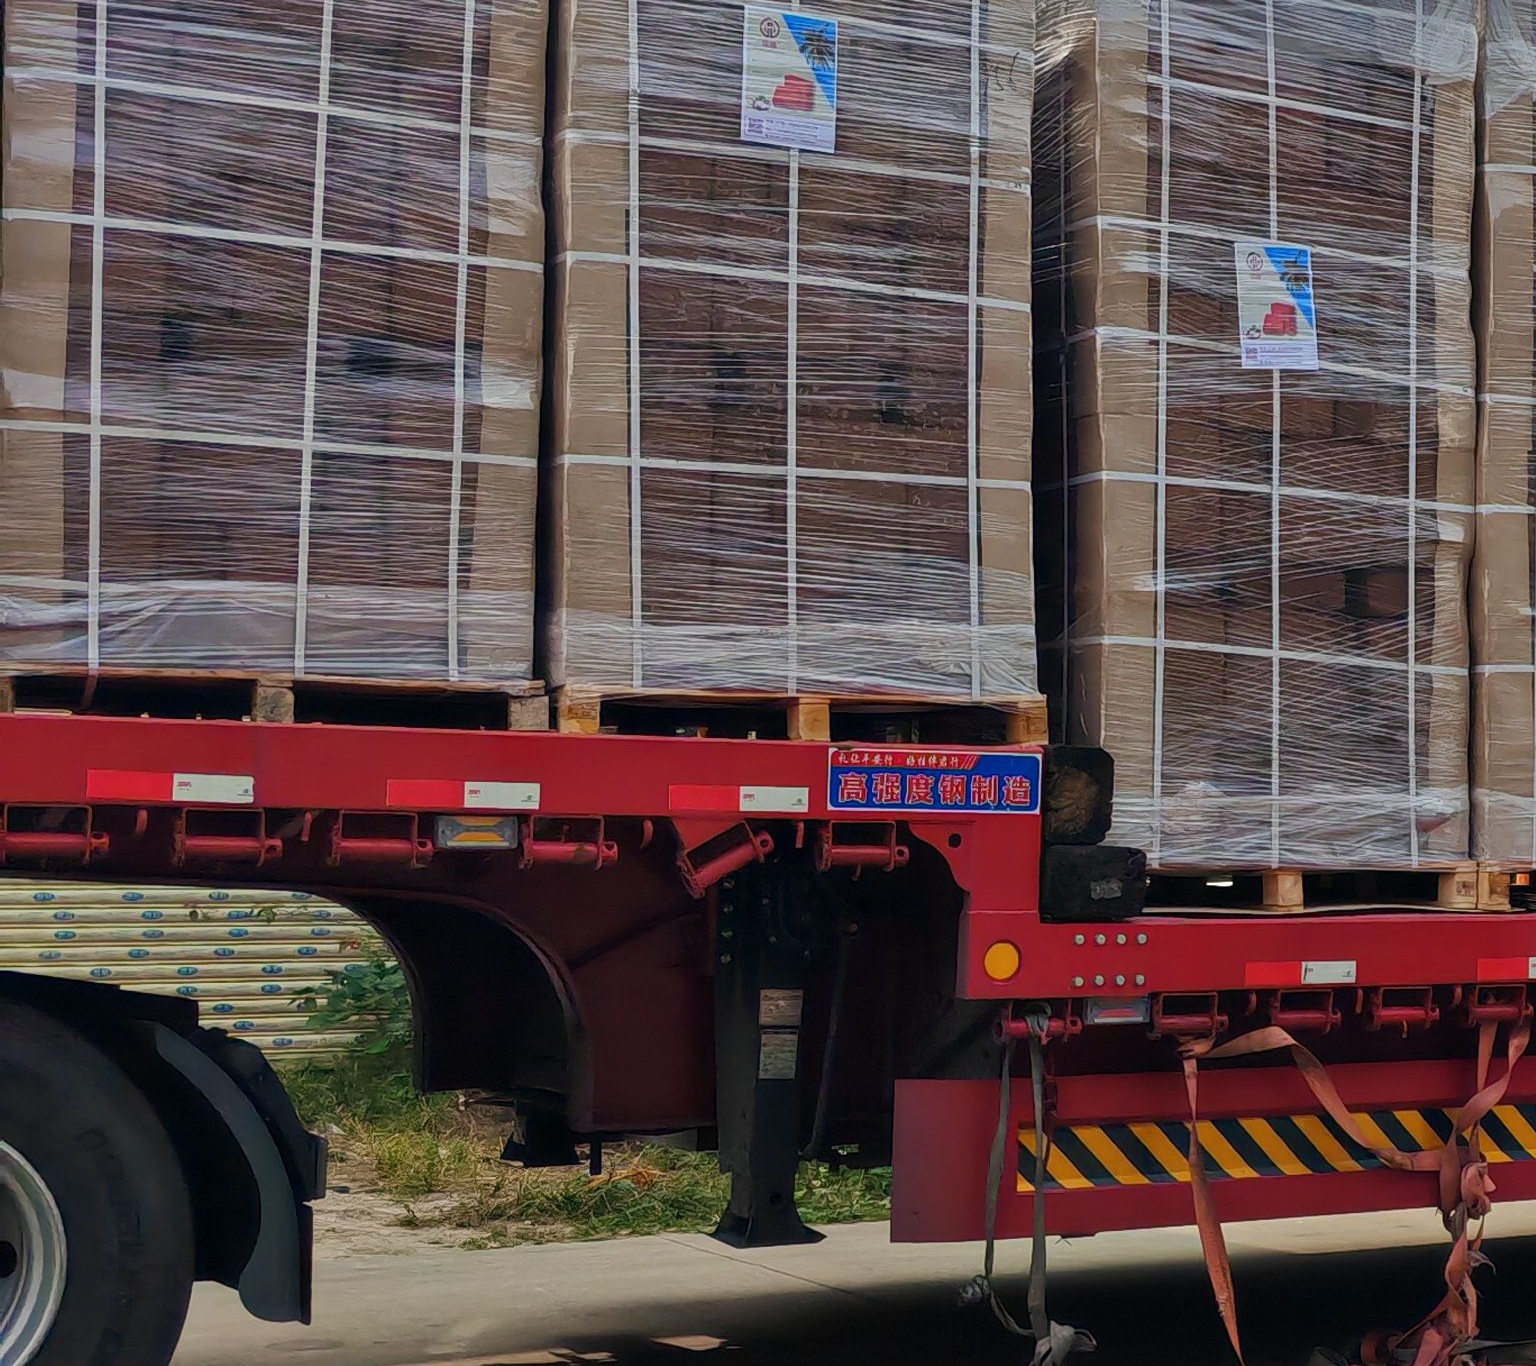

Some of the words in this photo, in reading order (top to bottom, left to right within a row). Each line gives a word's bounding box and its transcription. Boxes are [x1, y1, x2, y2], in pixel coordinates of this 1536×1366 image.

[838, 772, 1032, 806] 高强度钢制造
